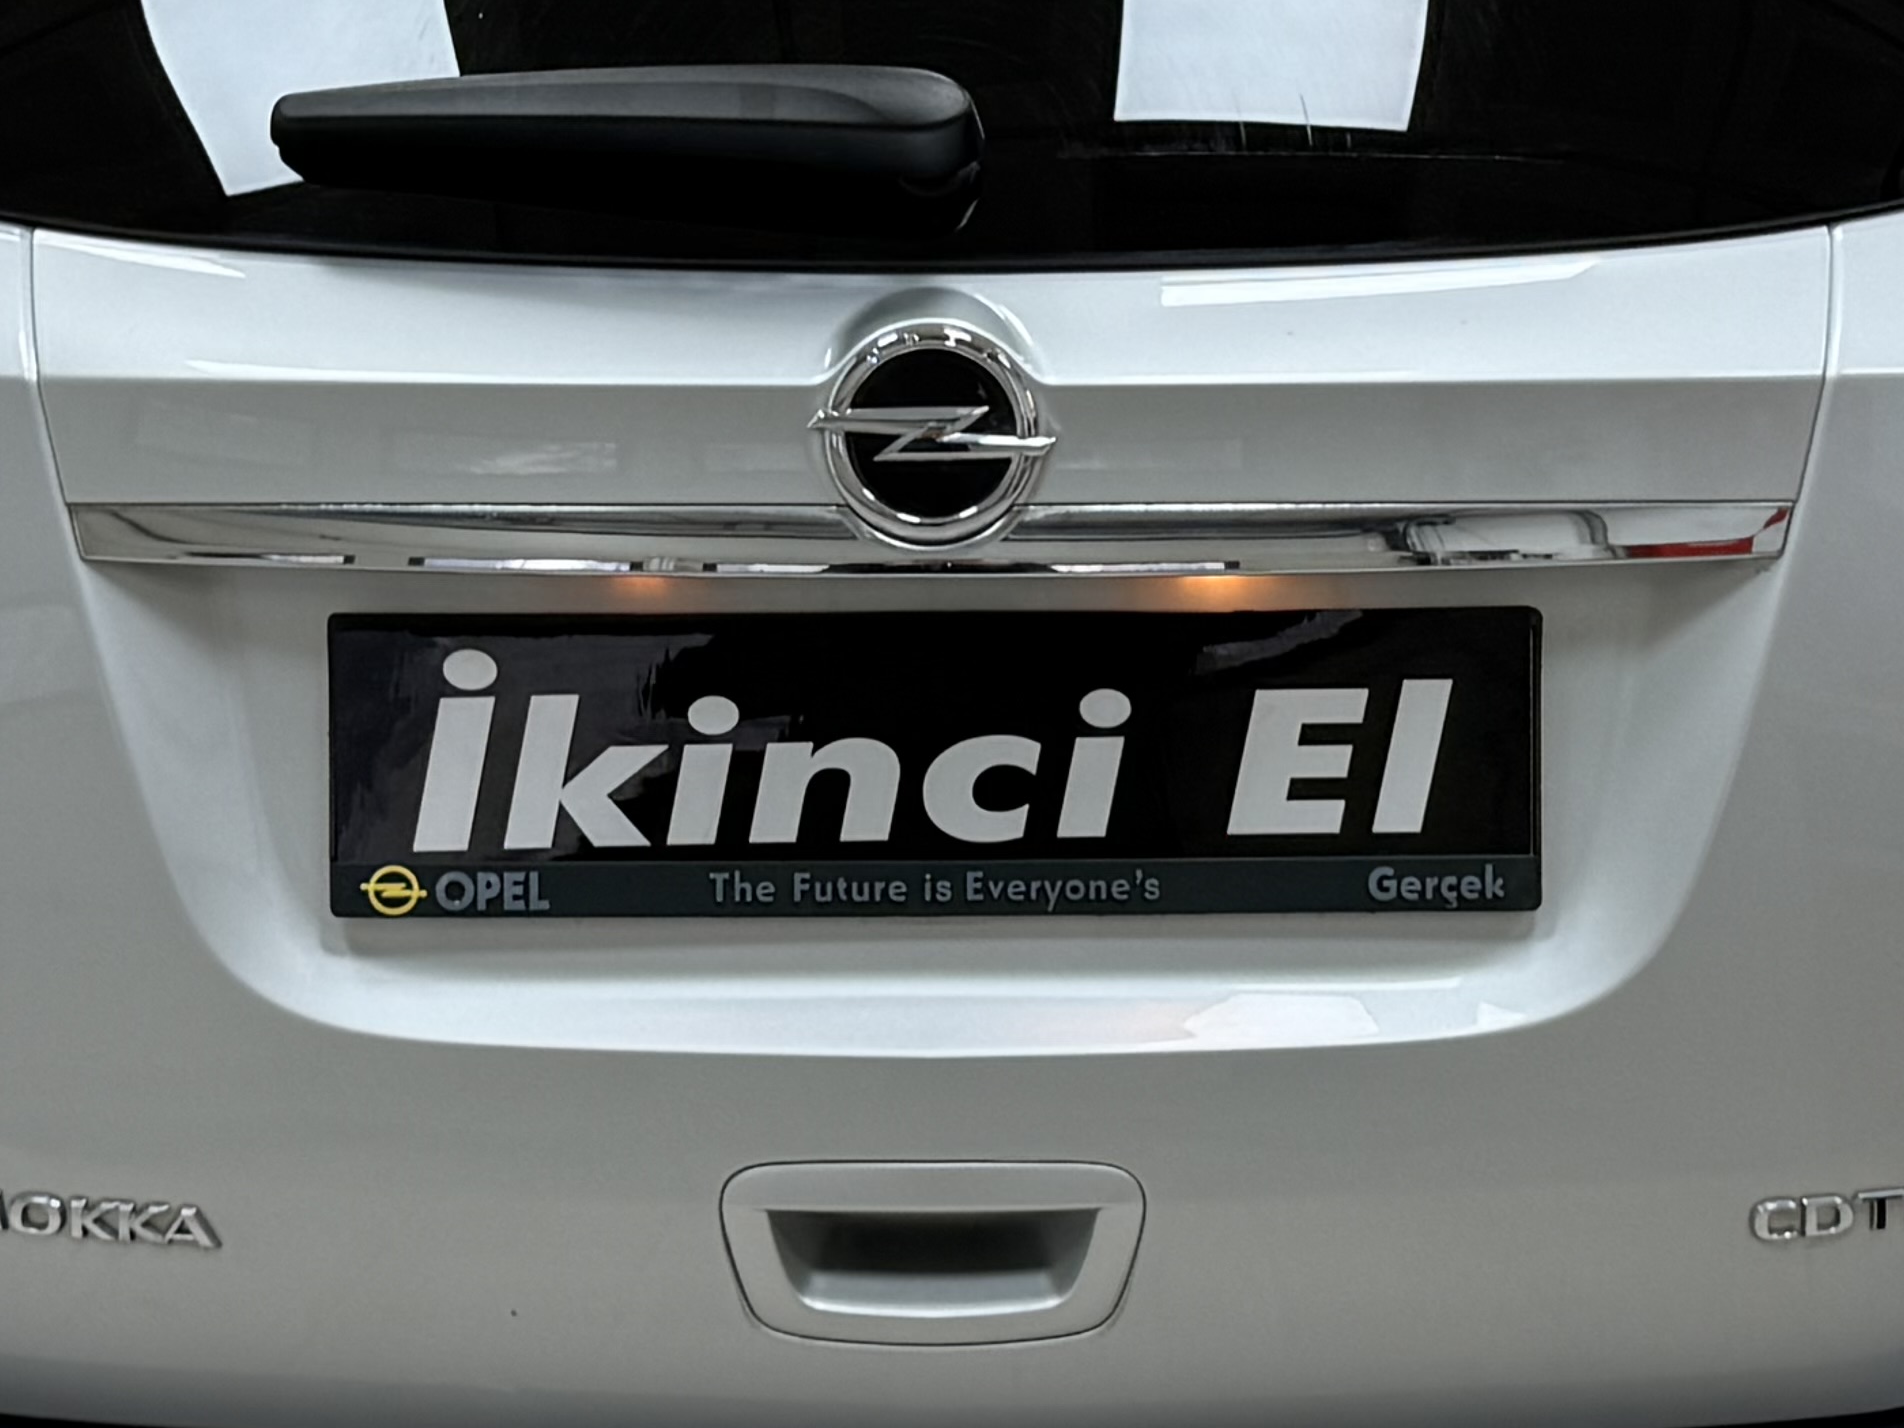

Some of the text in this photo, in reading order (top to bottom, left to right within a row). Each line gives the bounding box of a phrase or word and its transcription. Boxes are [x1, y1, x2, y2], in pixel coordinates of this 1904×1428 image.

[411, 648, 1454, 853] İkinci El
[435, 871, 550, 911] OPEL
[709, 871, 775, 902] The
[793, 872, 908, 903] Future
[923, 873, 952, 902] is
[1368, 863, 1505, 909] Gerçek
